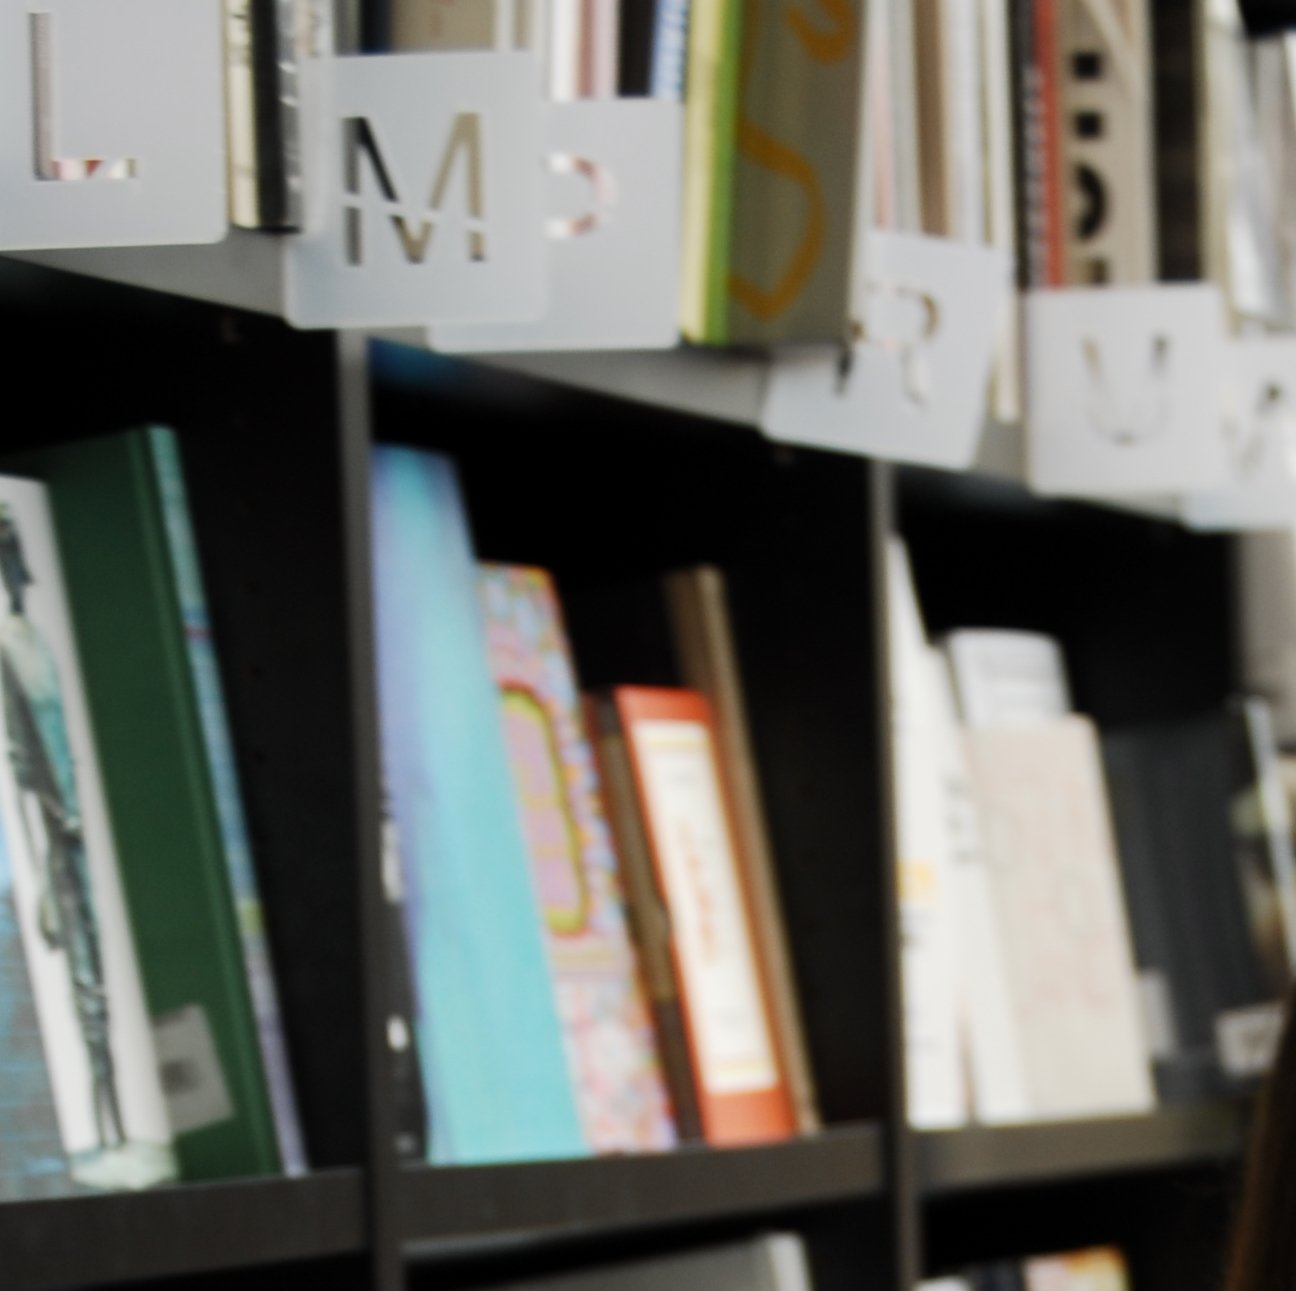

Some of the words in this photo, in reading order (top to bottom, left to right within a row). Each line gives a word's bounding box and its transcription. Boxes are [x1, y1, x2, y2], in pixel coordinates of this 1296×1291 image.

[28, 12, 136, 181] L
[342, 113, 485, 266] M
[835, 283, 940, 408] R
[1083, 334, 1174, 445] U
